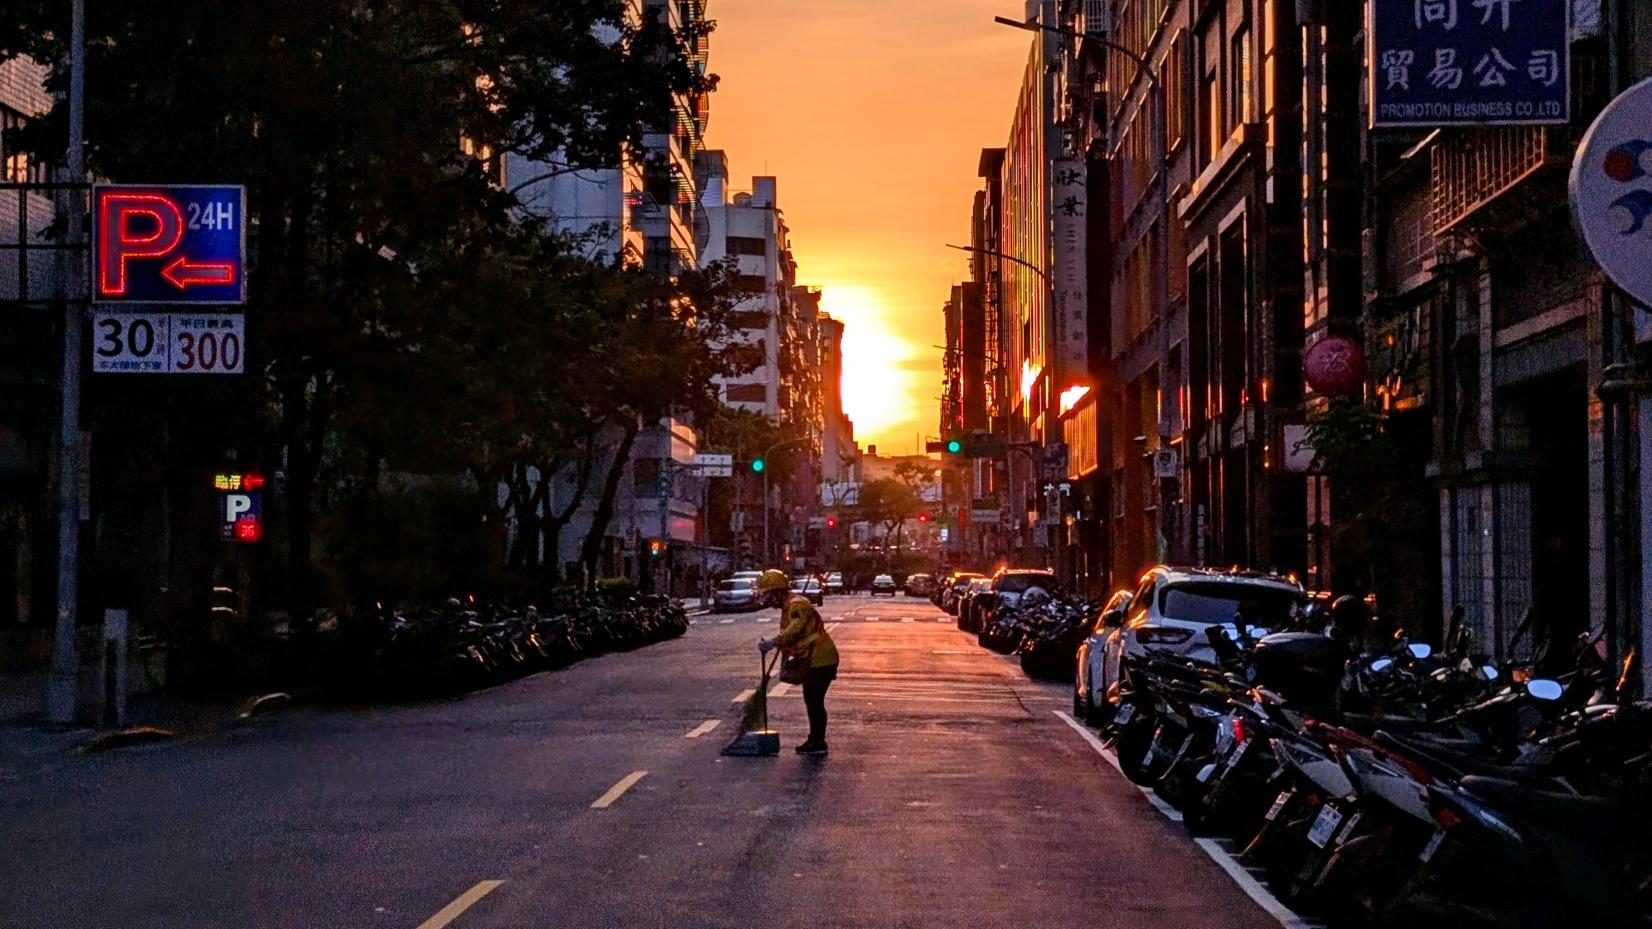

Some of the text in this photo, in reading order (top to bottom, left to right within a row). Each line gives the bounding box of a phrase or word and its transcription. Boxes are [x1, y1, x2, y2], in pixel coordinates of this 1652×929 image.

[1381, 47, 1560, 91] 貿易公司
[1380, 102, 1451, 119] PROMOTION
[1453, 101, 1512, 118] BUSINESS
[1055, 168, 1085, 217] 欣葉
[187, 202, 233, 231] 24H
[101, 192, 184, 294] P
[97, 318, 155, 358] 30
[176, 332, 240, 370] 300
[226, 494, 252, 522] P
